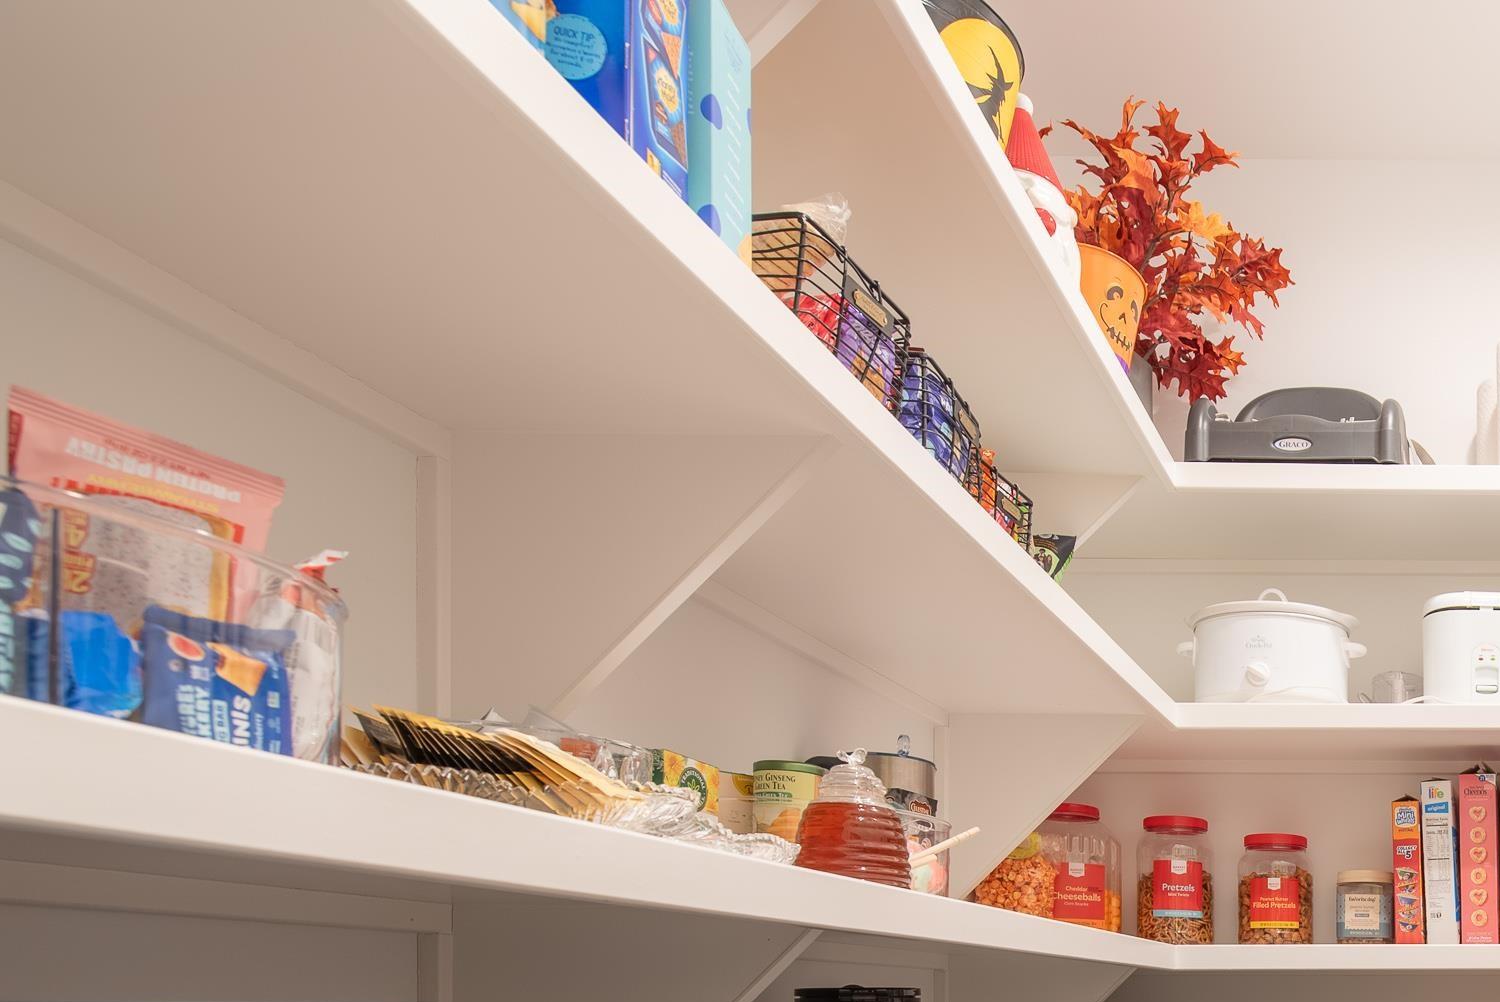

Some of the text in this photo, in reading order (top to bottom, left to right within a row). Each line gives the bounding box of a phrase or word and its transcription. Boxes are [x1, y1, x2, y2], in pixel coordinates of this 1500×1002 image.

[553, 26, 577, 39] QUICK
[1279, 440, 1309, 448] GRACO
[231, 694, 252, 746] INIS
[765, 772, 796, 784] GINSENG
[772, 782, 786, 790] TEA
[1428, 786, 1444, 798] life
[1397, 809, 1415, 819] Mini
[1405, 850, 1412, 859] 5
[1162, 883, 1196, 893] Pretzels
[1050, 892, 1101, 902] Cheeseballs
